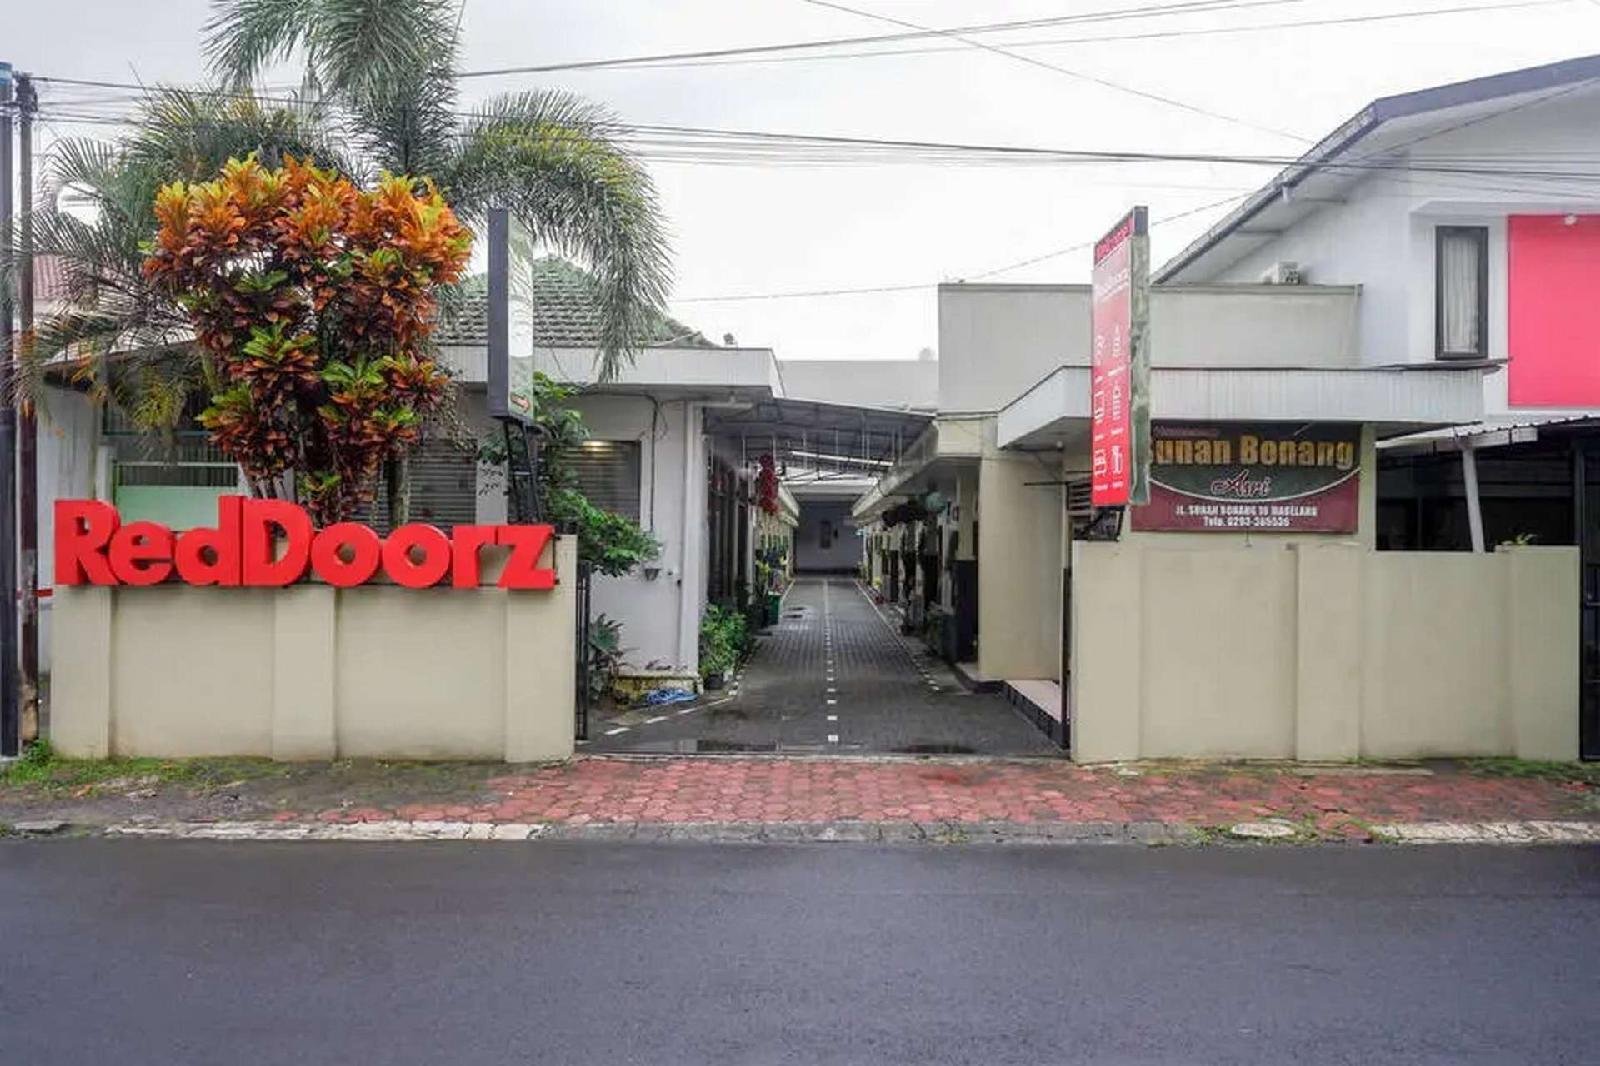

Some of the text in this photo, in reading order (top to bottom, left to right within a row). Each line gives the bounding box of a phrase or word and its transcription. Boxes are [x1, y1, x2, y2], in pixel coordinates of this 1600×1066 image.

[1151, 435, 1354, 470] unan Bonang
[54, 495, 556, 591] RedDoorz
